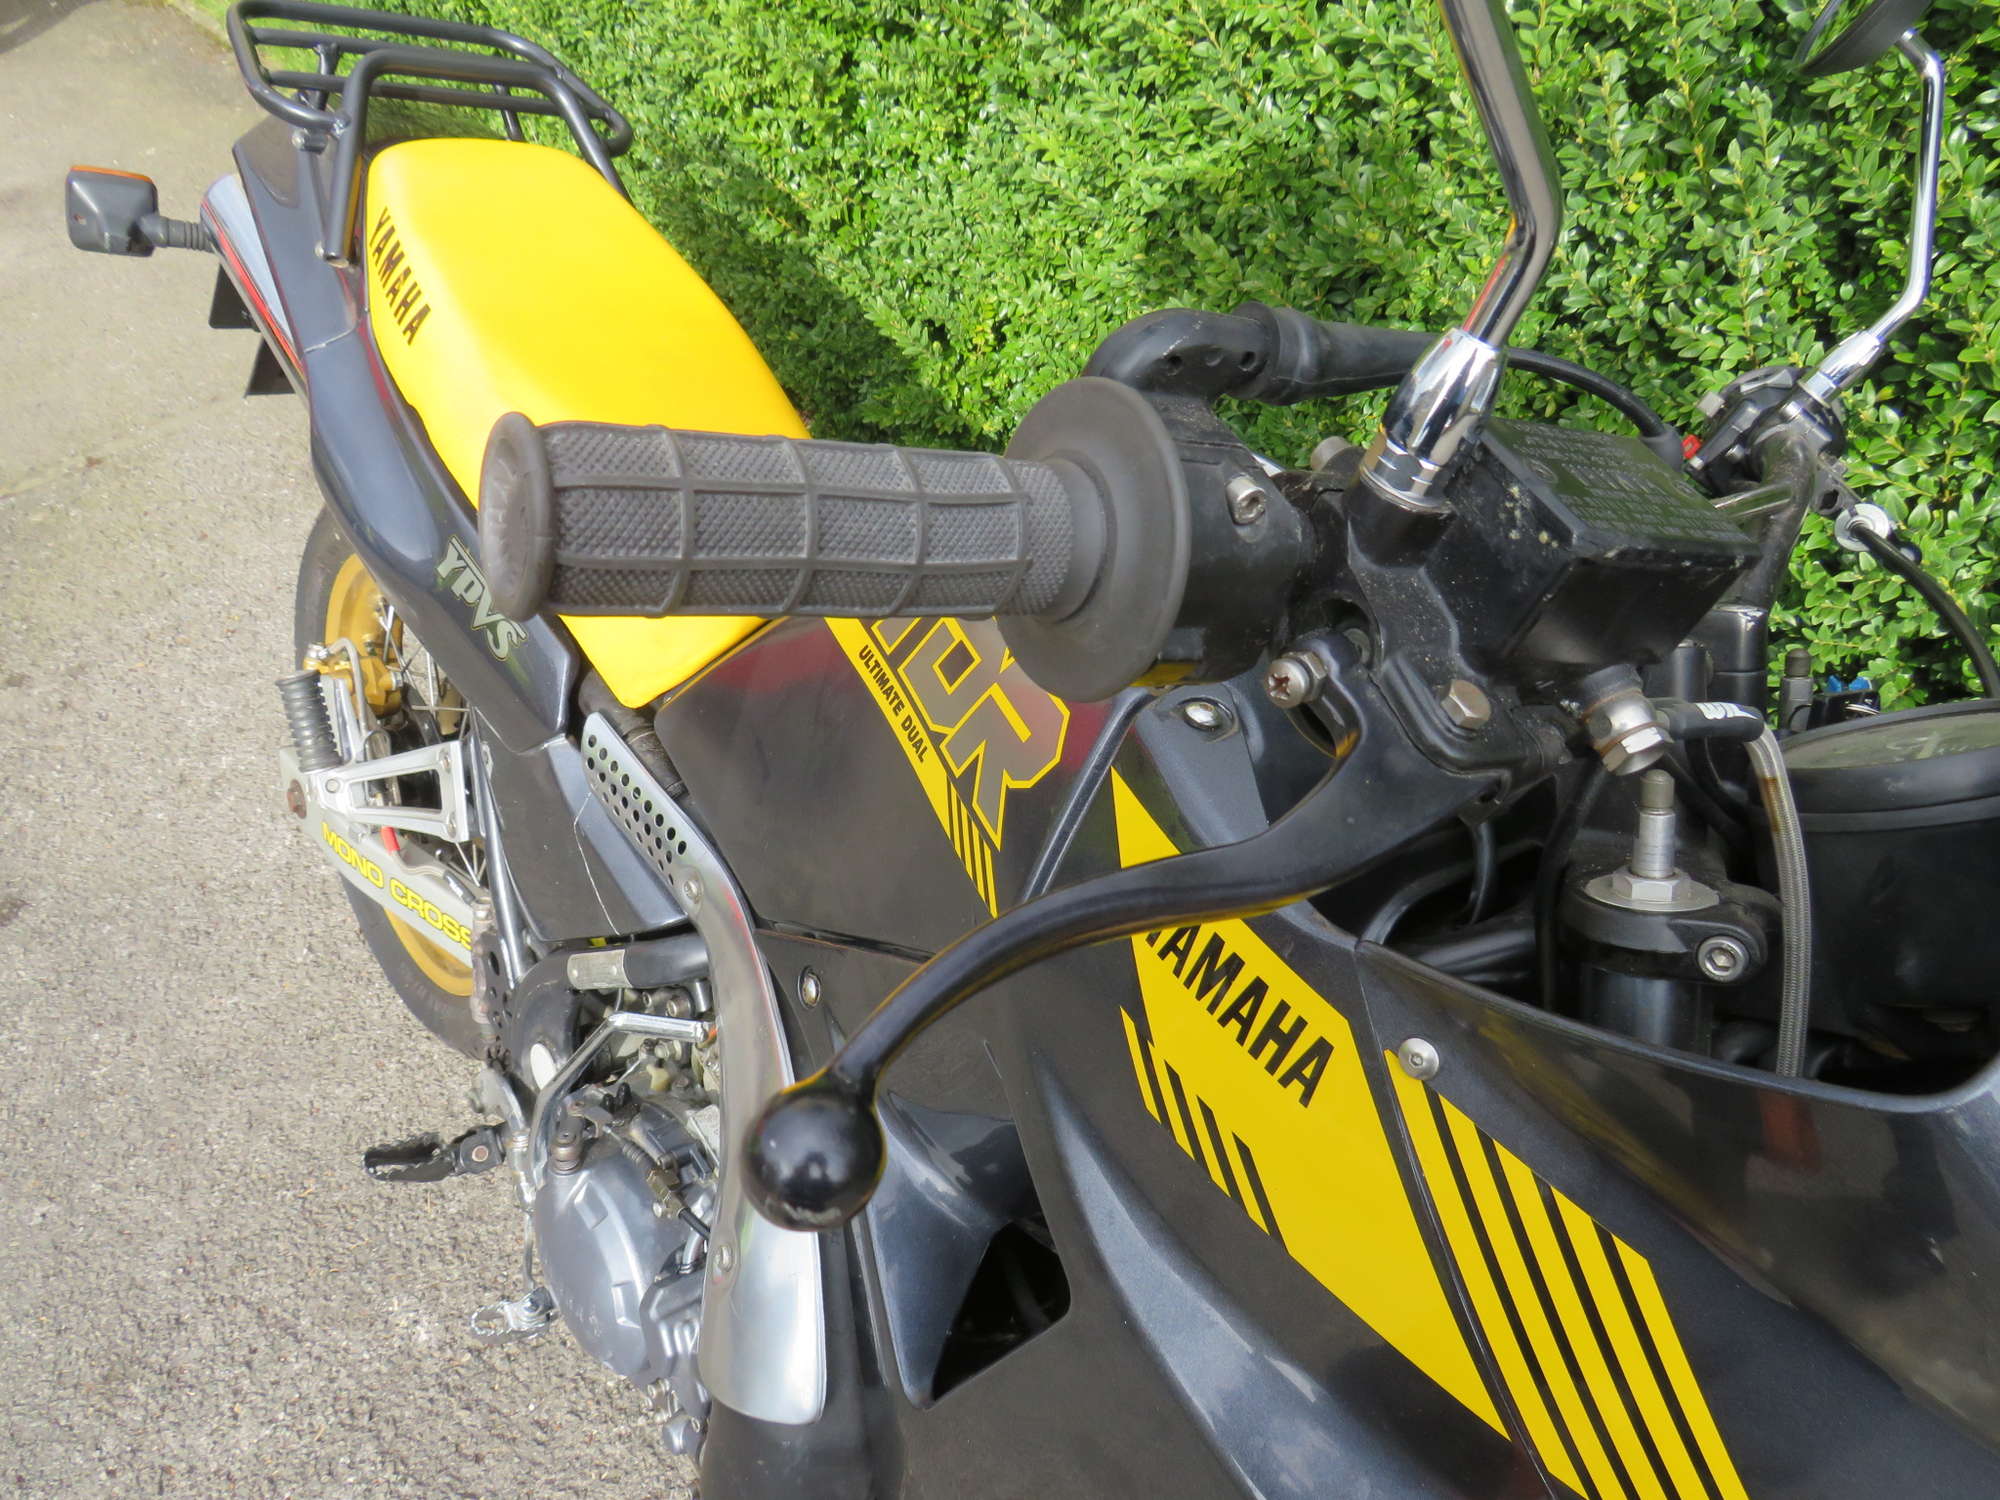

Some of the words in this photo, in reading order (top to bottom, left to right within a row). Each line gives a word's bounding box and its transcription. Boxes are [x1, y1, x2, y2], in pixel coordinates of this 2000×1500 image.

[369, 206, 431, 346] YAMAHA
[436, 535, 528, 661] YPVS
[858, 644, 905, 717] ULTIMATE
[901, 714, 929, 764] DUAL
[870, 616, 1070, 852] DR
[320, 821, 385, 889] MONO
